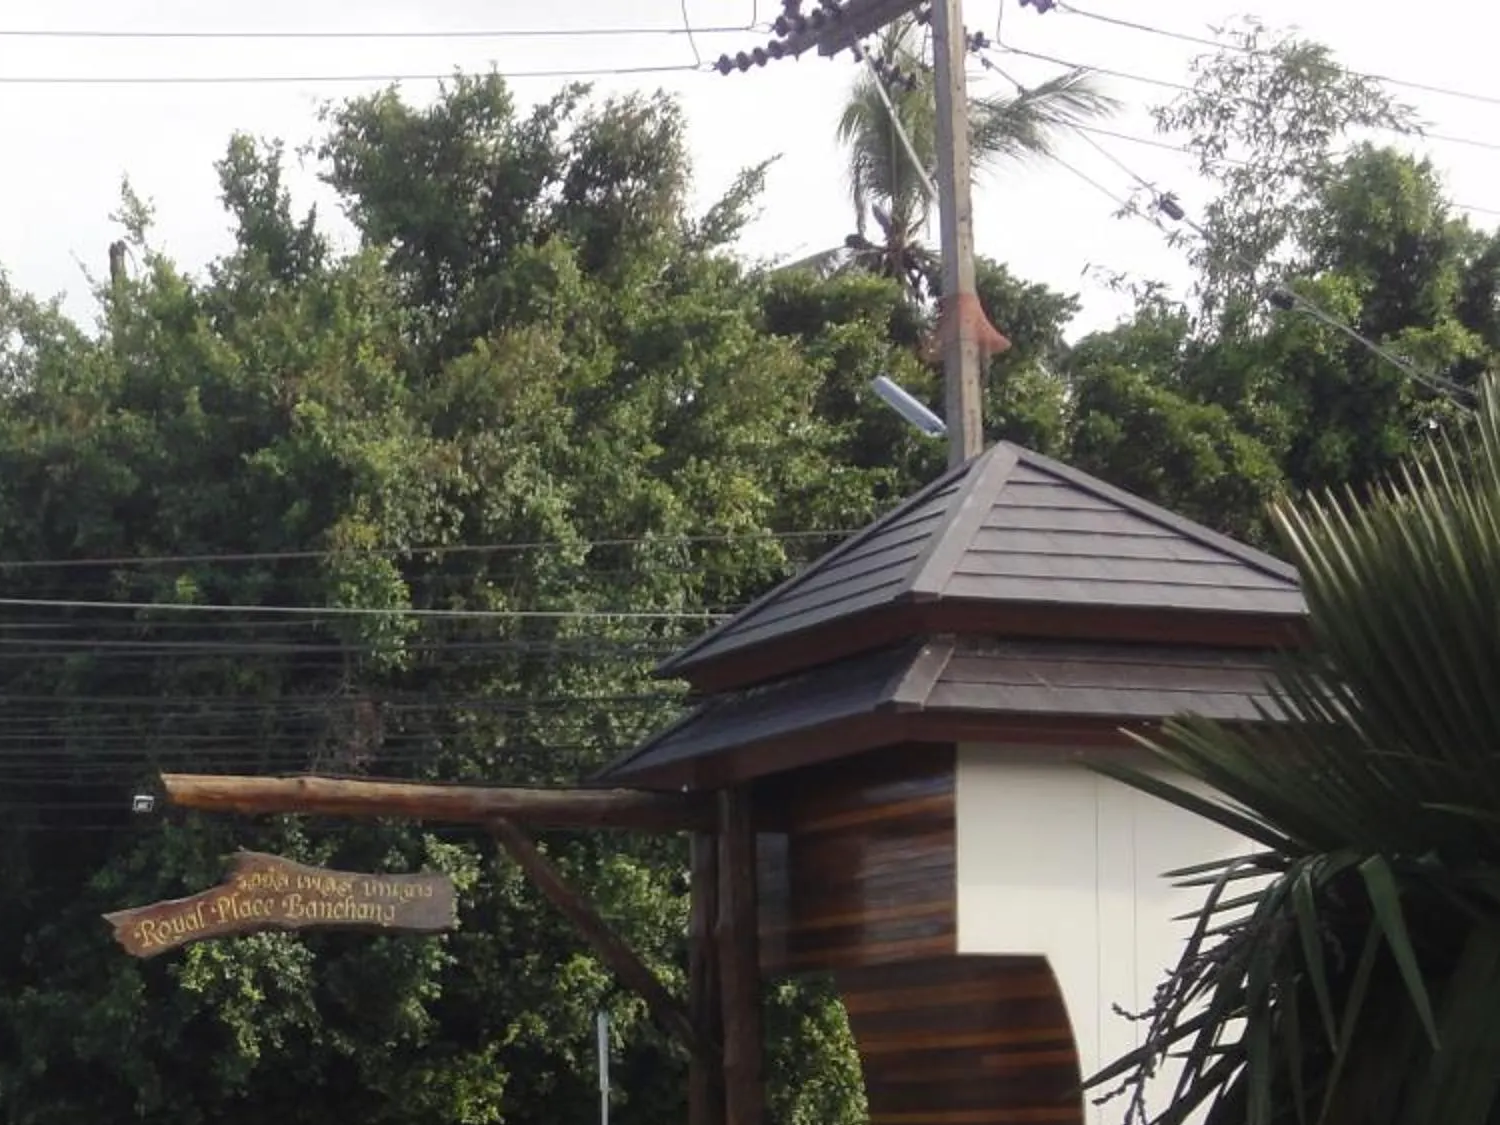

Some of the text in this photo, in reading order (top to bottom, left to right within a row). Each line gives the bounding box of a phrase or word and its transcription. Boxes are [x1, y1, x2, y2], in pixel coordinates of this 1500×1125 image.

[134, 893, 396, 947] Royal Place Banchang
